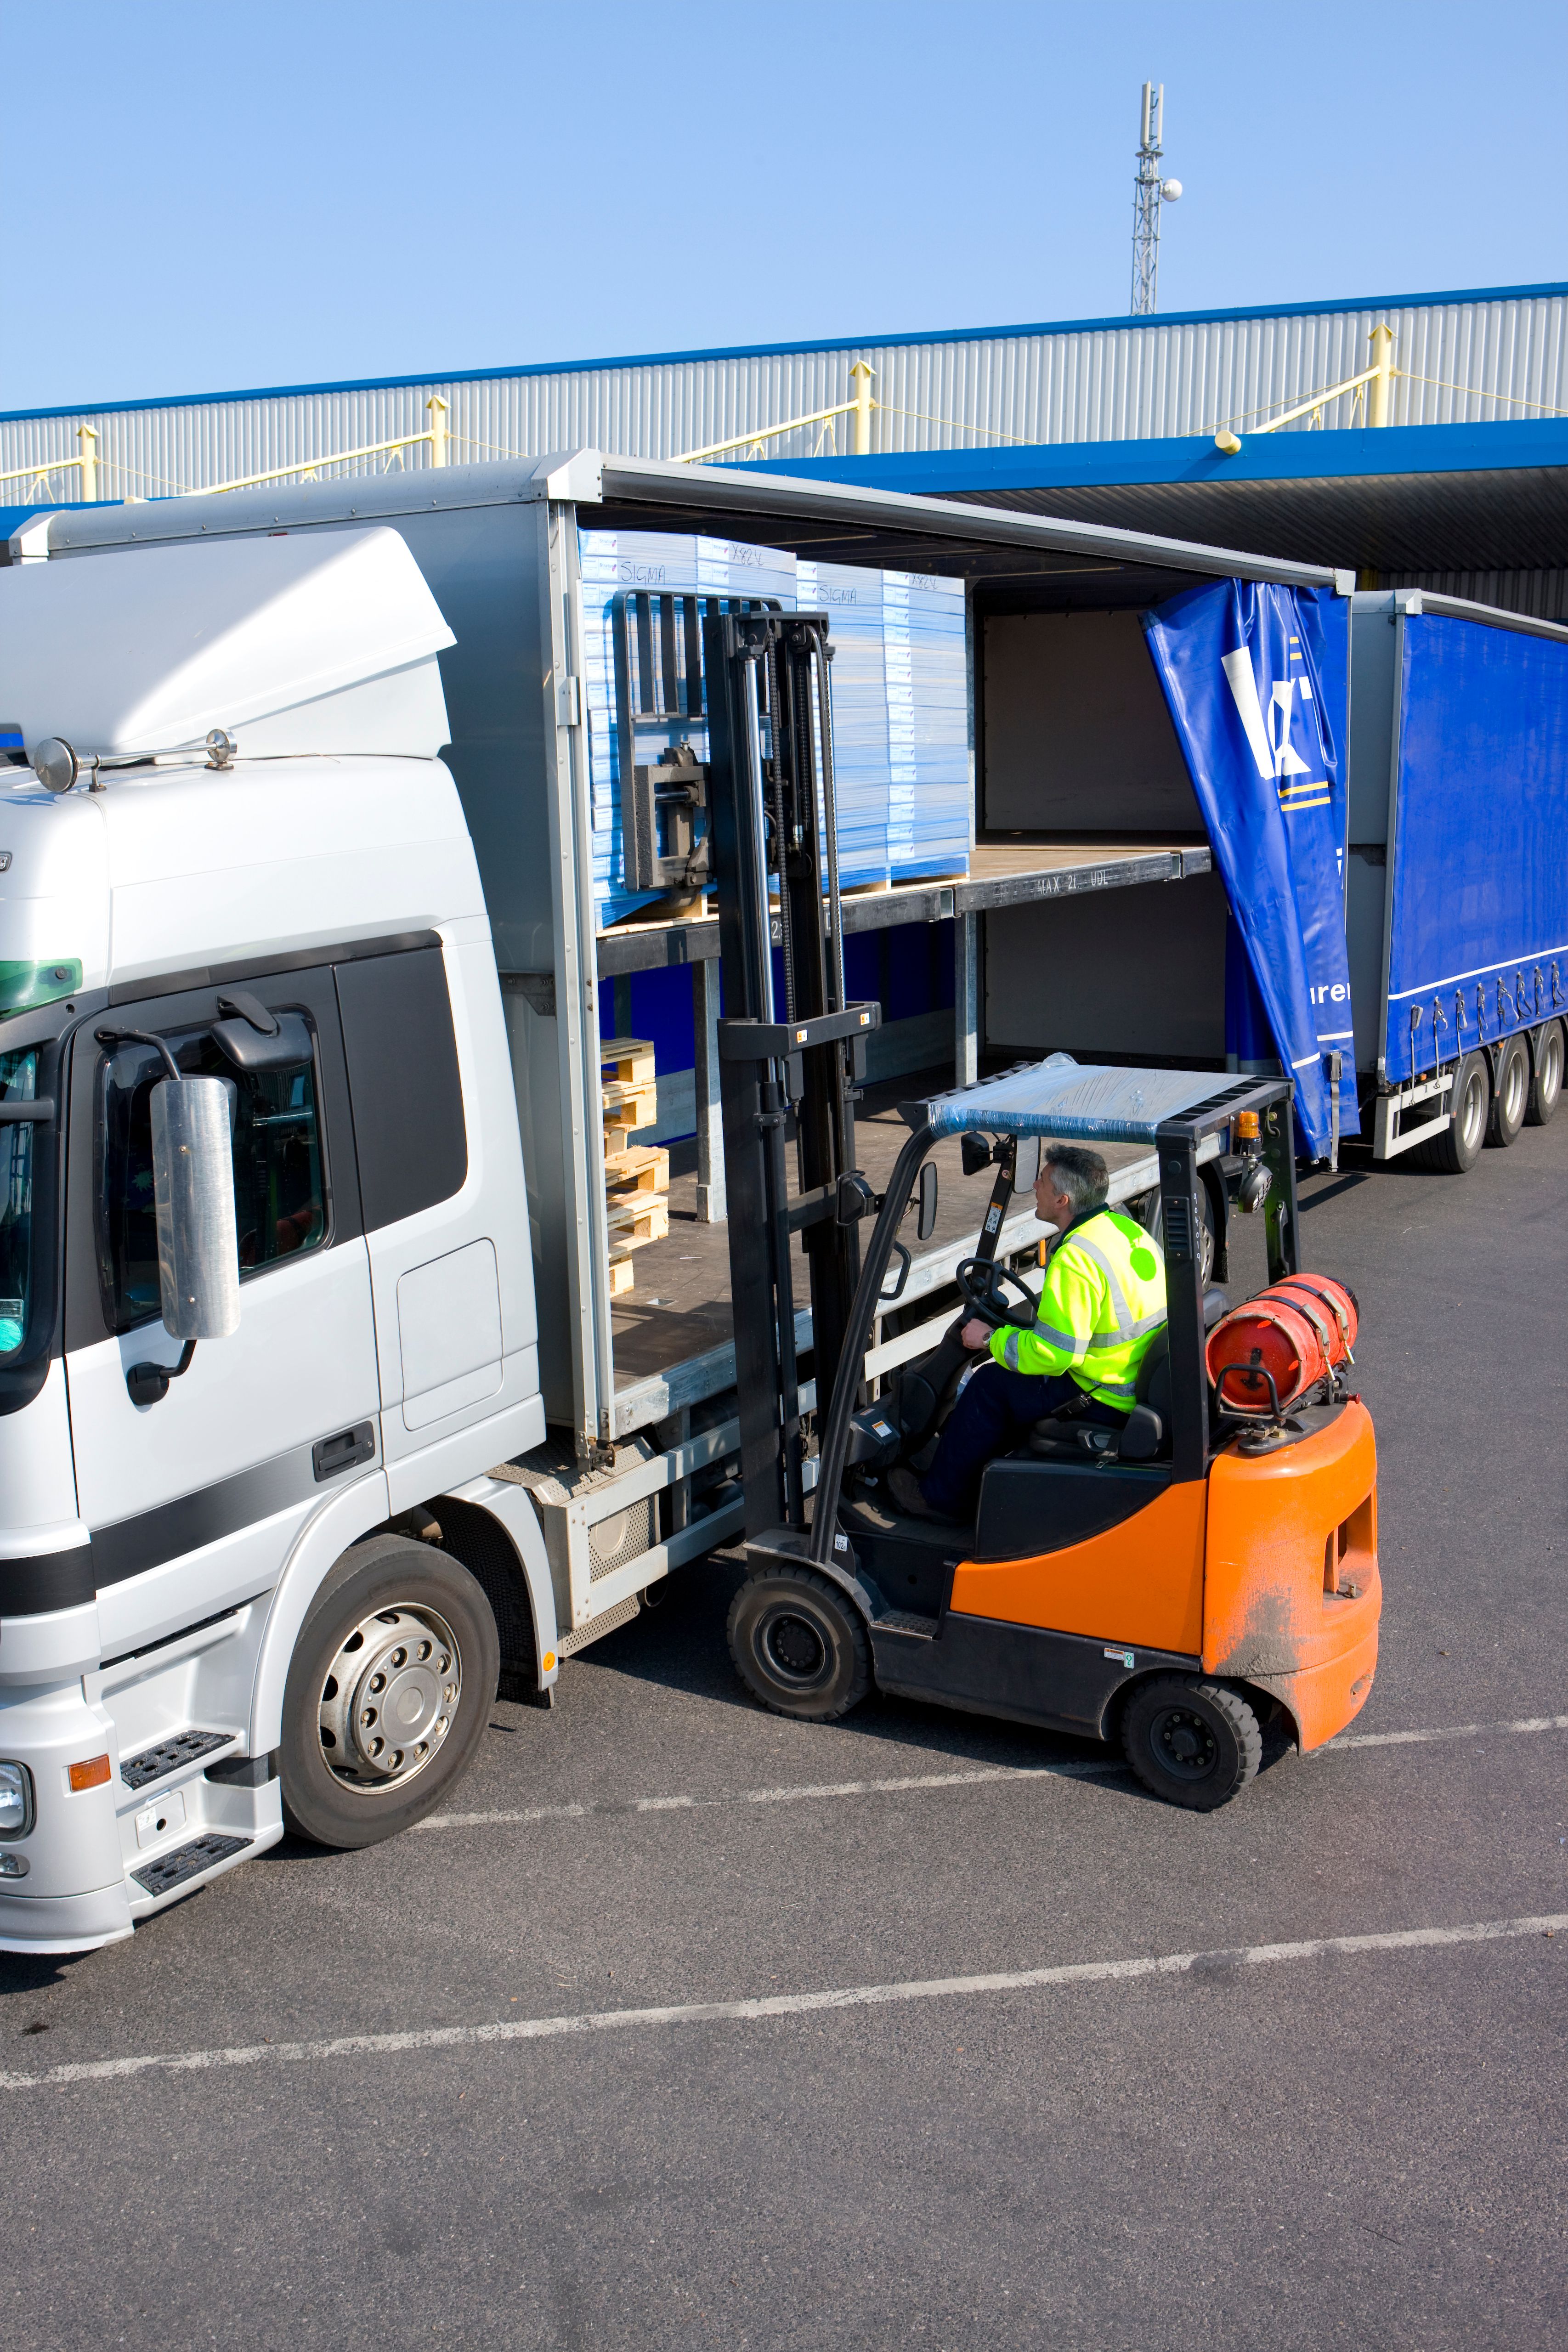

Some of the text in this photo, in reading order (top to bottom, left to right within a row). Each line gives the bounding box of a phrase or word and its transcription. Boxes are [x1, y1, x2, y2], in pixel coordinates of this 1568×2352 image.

[621, 561, 666, 586] SIGMA
[820, 585, 857, 605] SIGMA
[1038, 876, 1059, 894] MAX
[1091, 871, 1108, 886] UDL
